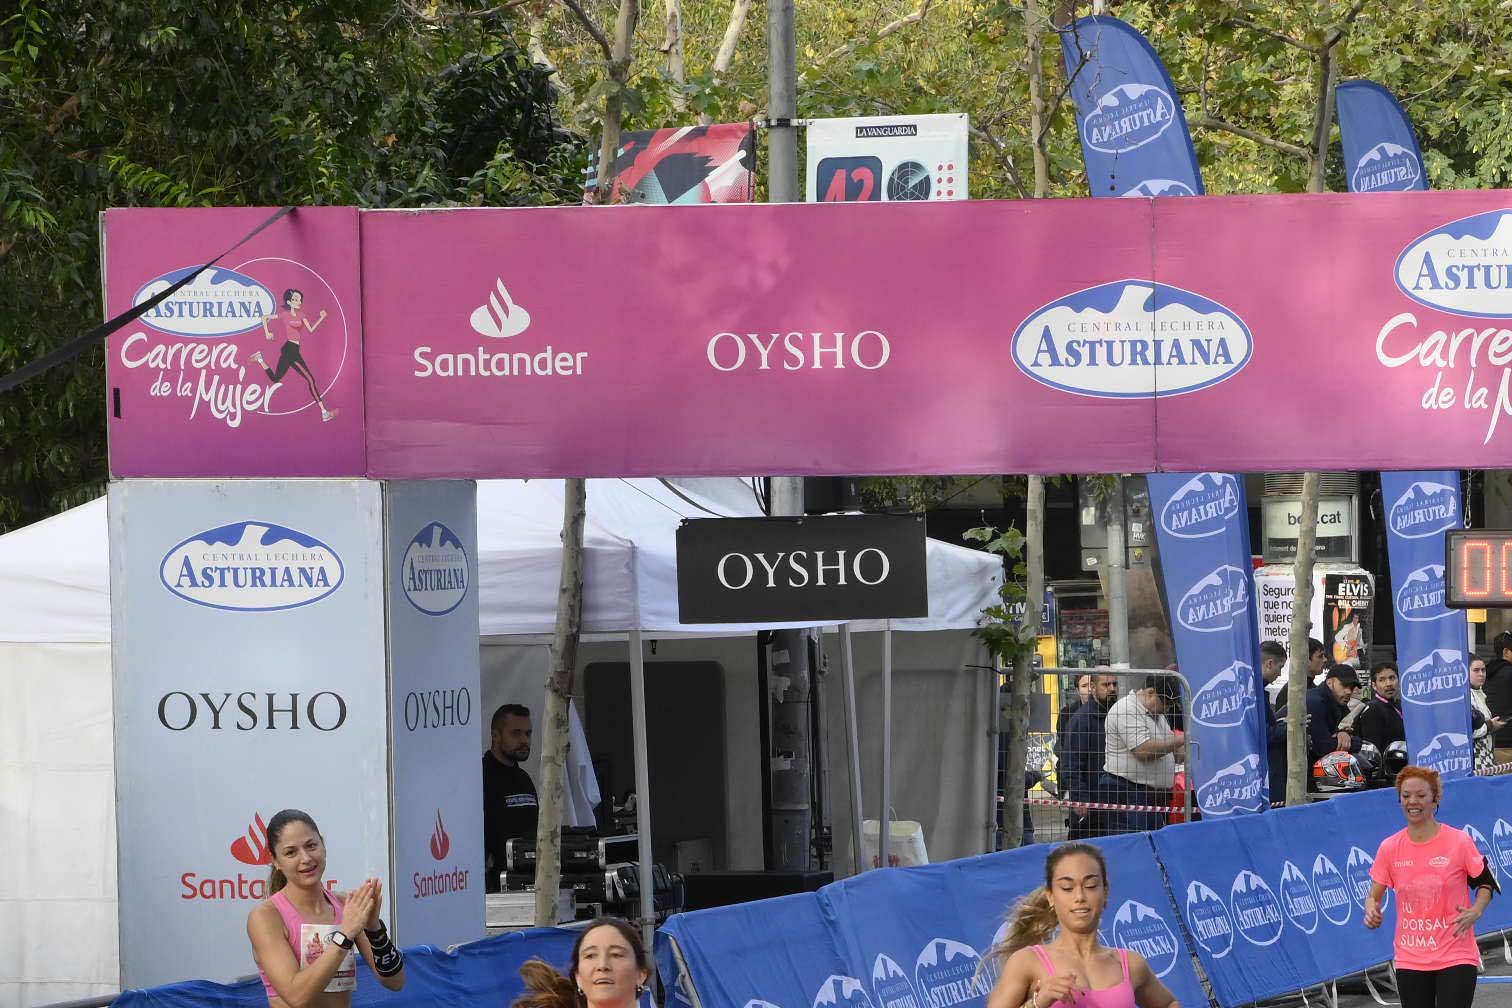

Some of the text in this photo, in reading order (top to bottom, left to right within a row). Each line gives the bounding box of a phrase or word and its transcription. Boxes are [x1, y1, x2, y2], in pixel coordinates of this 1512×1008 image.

[146, 291, 264, 318] ASTURIANA
[1066, 320, 1226, 333] CENTRAL LECHERA
[120, 332, 239, 370] Carrera
[413, 345, 588, 377] Santander
[706, 329, 891, 372] OYSHO
[1030, 324, 1234, 368] ASTURIANA
[150, 366, 283, 428] de la Mujer
[1421, 370, 1456, 410] de
[1464, 369, 1489, 410] la
[175, 554, 331, 588] ASTURIANA
[202, 551, 325, 562] CENTRAL LECHERA
[717, 547, 890, 590] OYSHO
[407, 561, 466, 592] ASTURIANA
[1338, 583, 1369, 596] ELVIS
[1264, 601, 1281, 611] que
[1264, 610, 1293, 625] quiere
[157, 691, 348, 732] OYSHO
[404, 687, 472, 732] OYSHO
[412, 867, 470, 899] Santander
[1402, 917, 1449, 931] DORSAL
[1400, 934, 1438, 948] SUMA
